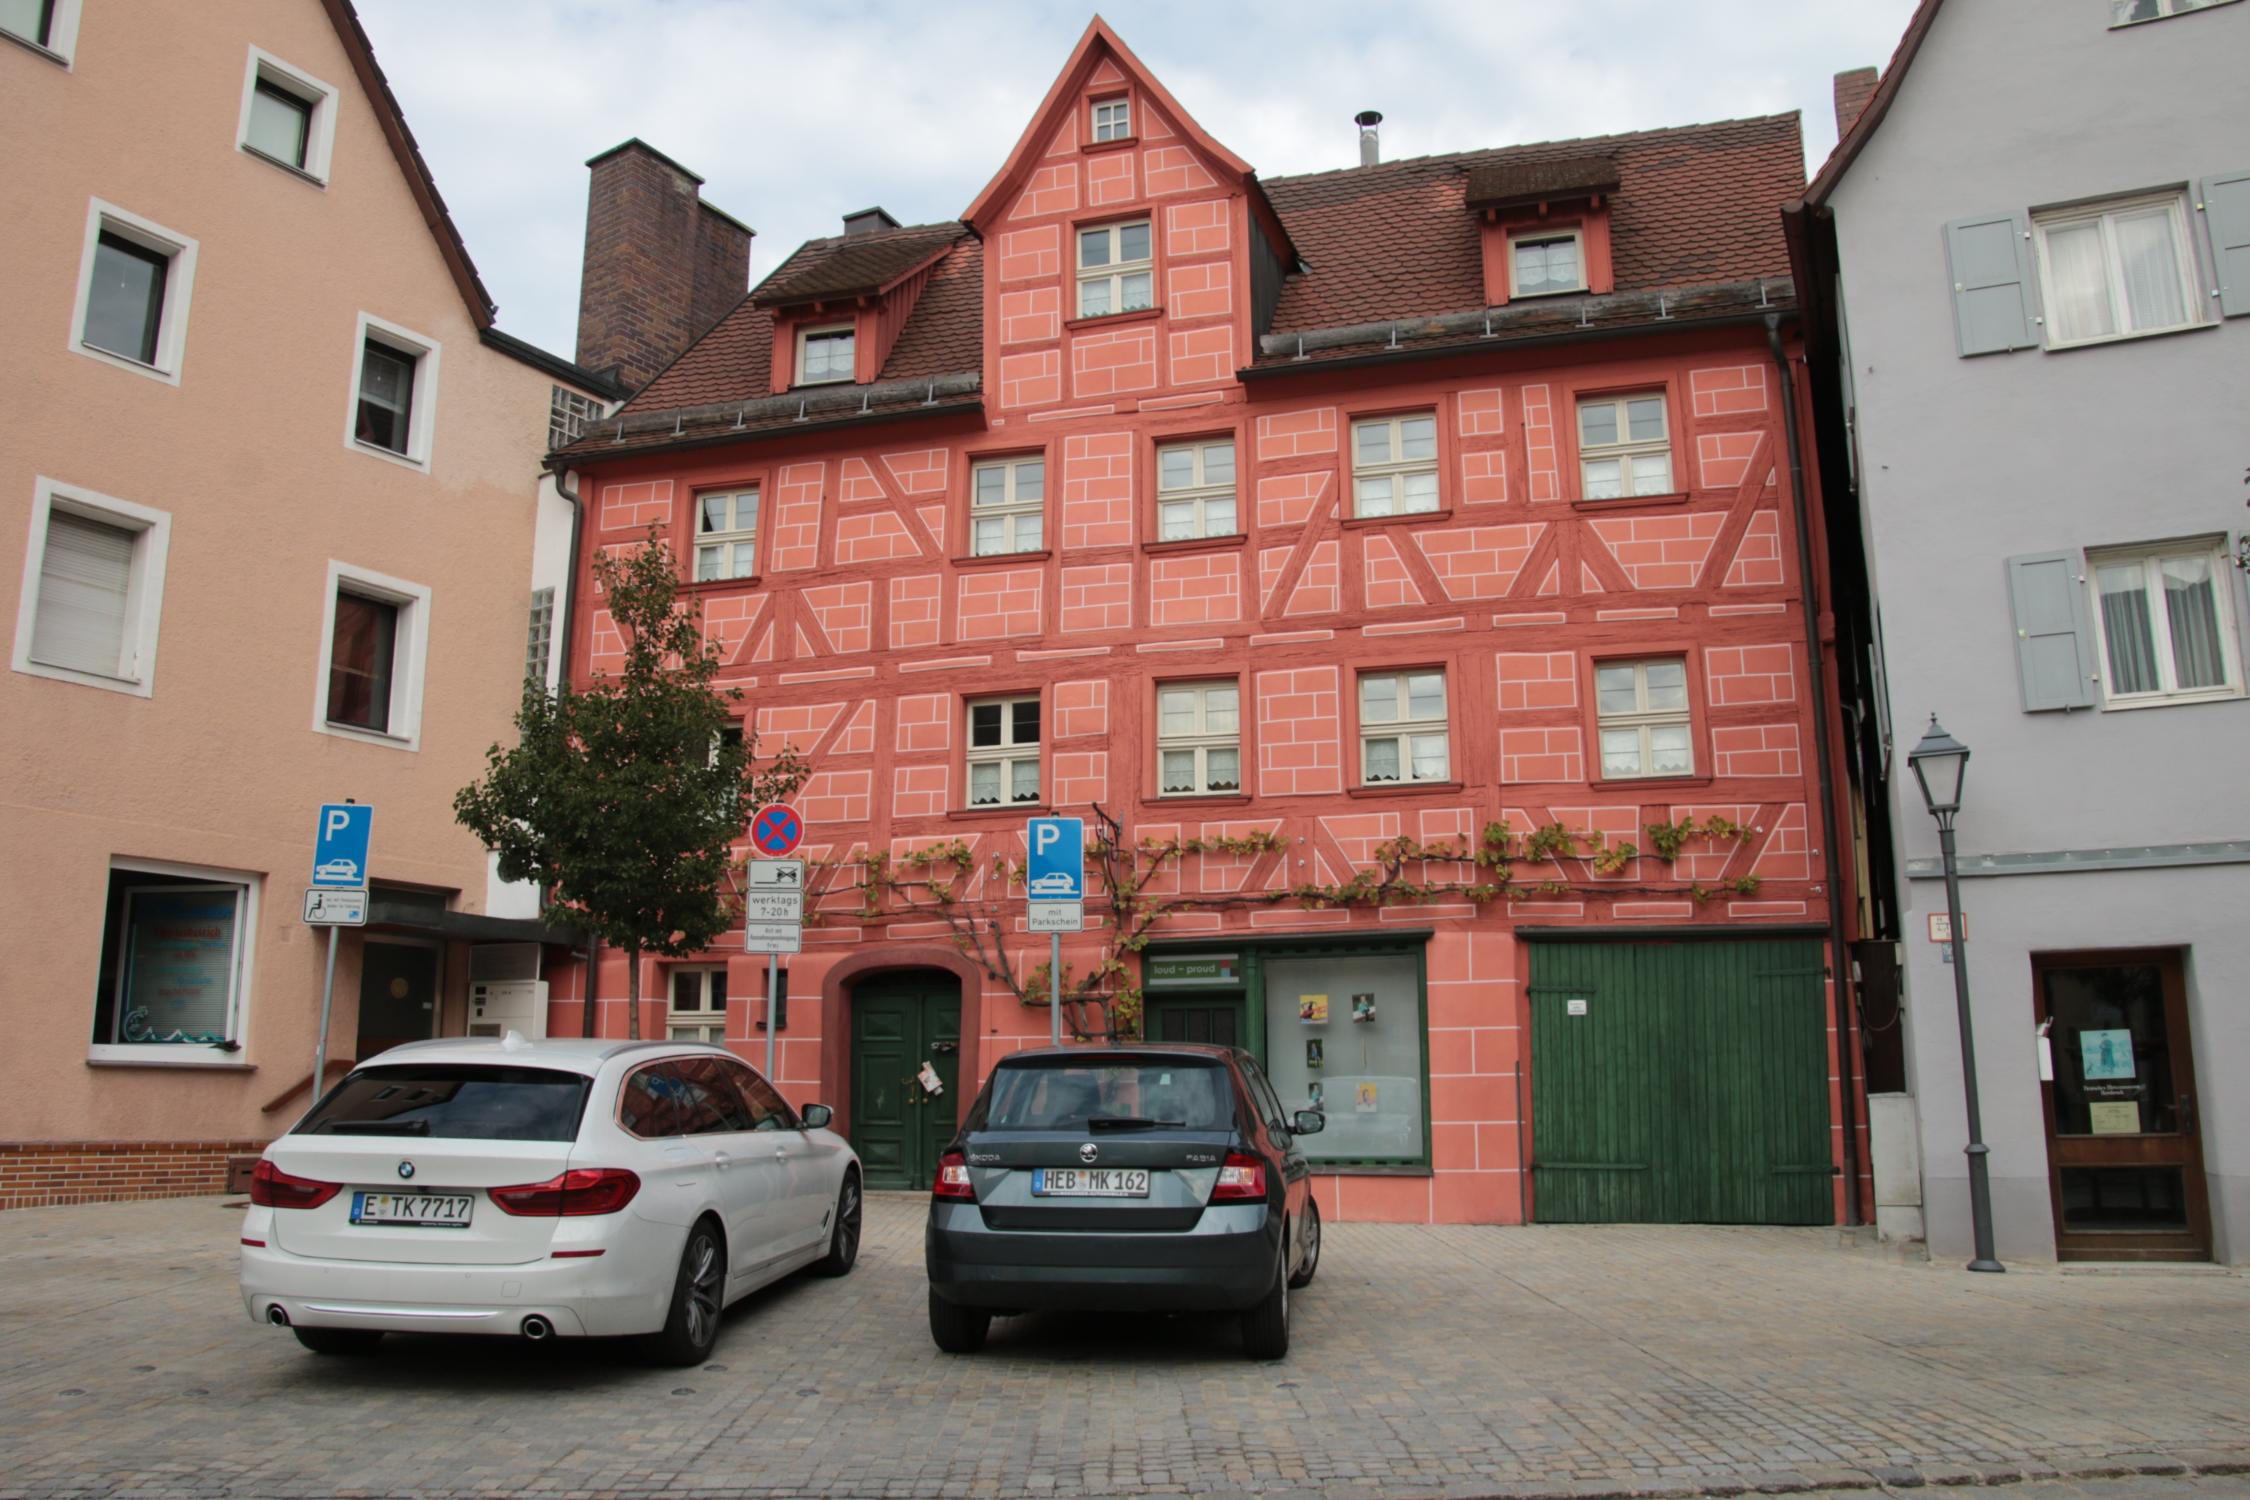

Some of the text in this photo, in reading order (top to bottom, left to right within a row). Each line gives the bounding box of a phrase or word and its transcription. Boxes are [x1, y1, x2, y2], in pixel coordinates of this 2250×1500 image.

[325, 810, 350, 842] P
[1037, 824, 1060, 855] P
[752, 896, 798, 906] werktags
[1032, 918, 1079, 926] Parkschein
[1153, 965, 1176, 974] loud
[1186, 964, 1216, 974] proud
[1044, 1170, 1146, 1191] HEB MK 162
[364, 1196, 470, 1218] E TK 7717
